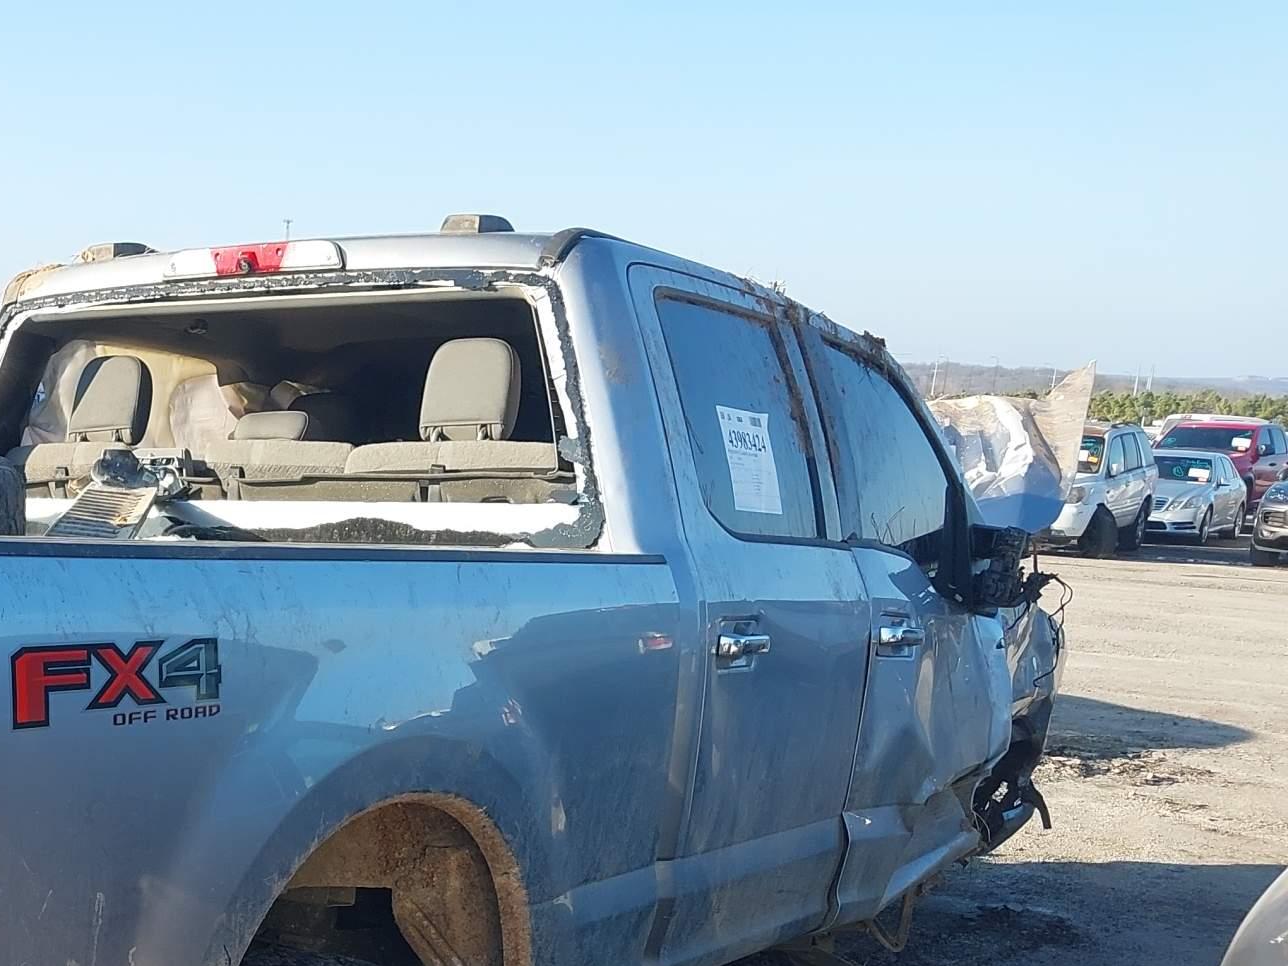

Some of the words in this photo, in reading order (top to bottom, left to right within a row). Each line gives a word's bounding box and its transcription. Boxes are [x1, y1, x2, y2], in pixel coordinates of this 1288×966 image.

[728, 429, 767, 453] 43983424
[11, 638, 222, 729] FX4
[113, 710, 158, 726] OFF
[165, 704, 221, 721] ROAD
